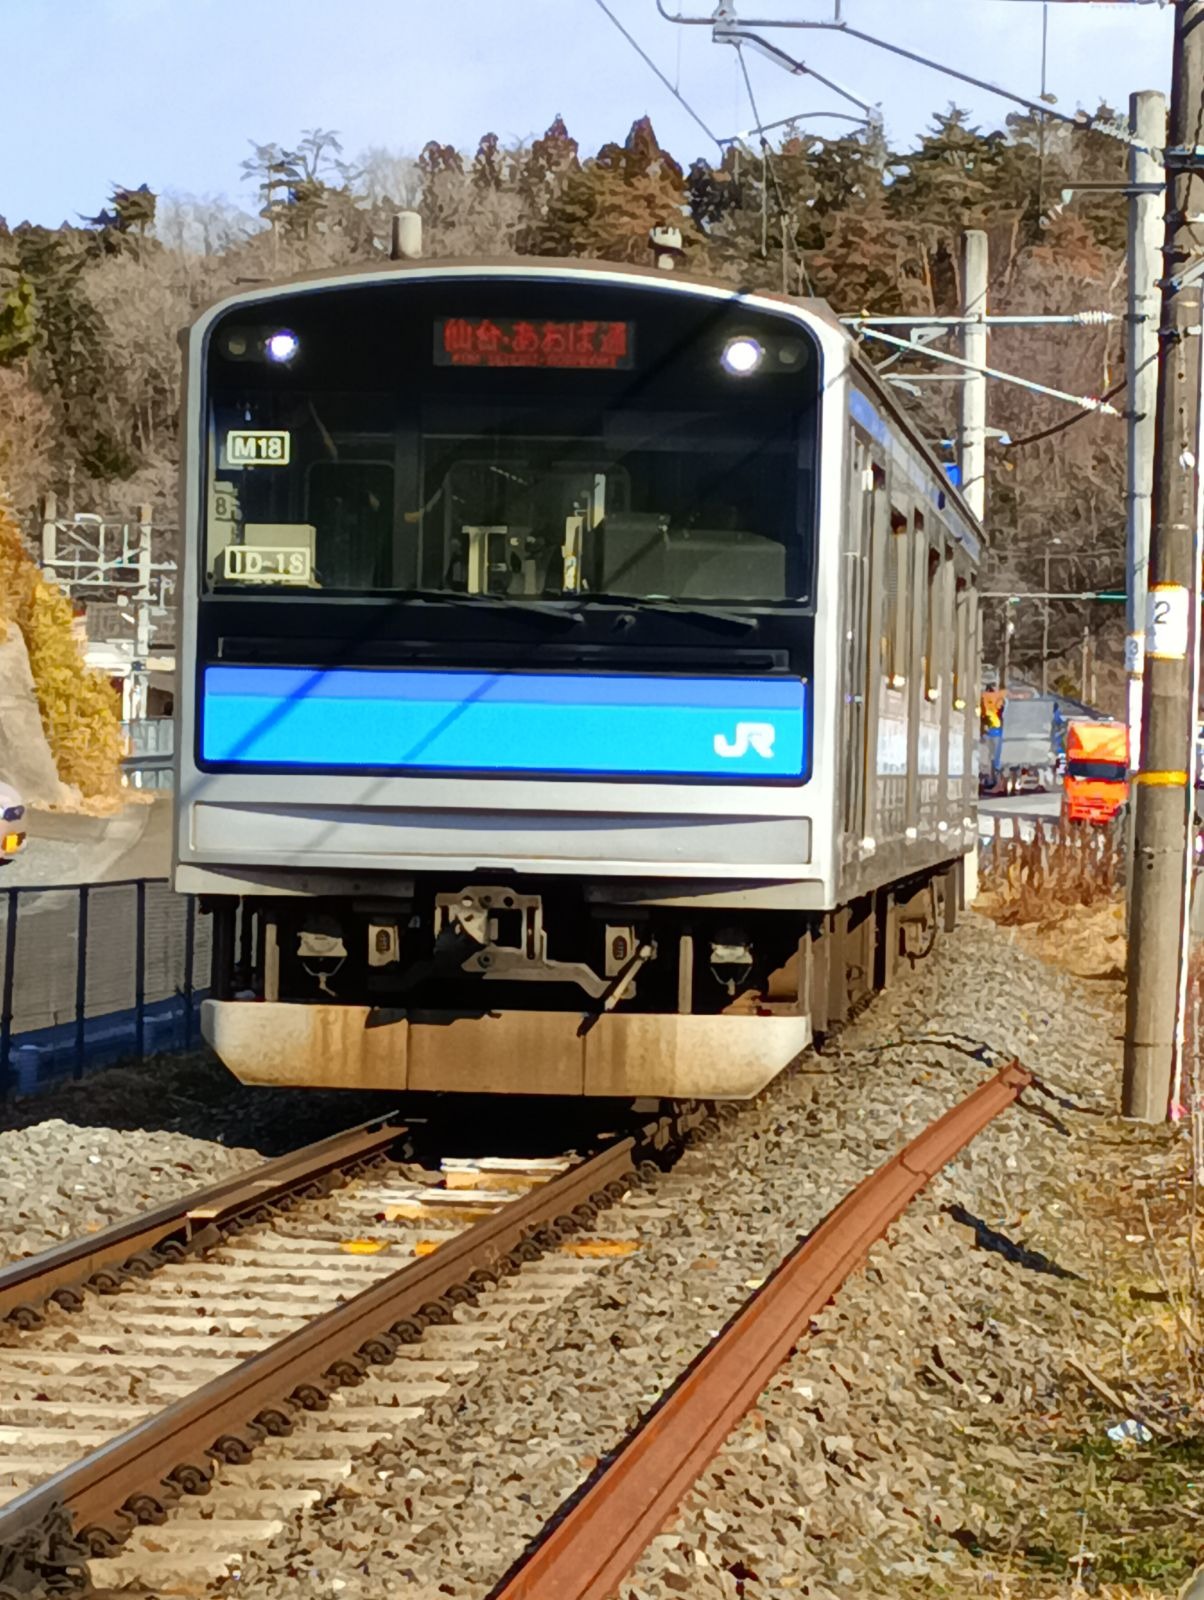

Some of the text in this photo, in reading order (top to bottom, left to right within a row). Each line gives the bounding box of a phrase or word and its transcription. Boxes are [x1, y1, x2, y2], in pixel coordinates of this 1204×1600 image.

[234, 437, 282, 458] M18
[1154, 601, 1171, 624] 2
[714, 722, 775, 758] JR
